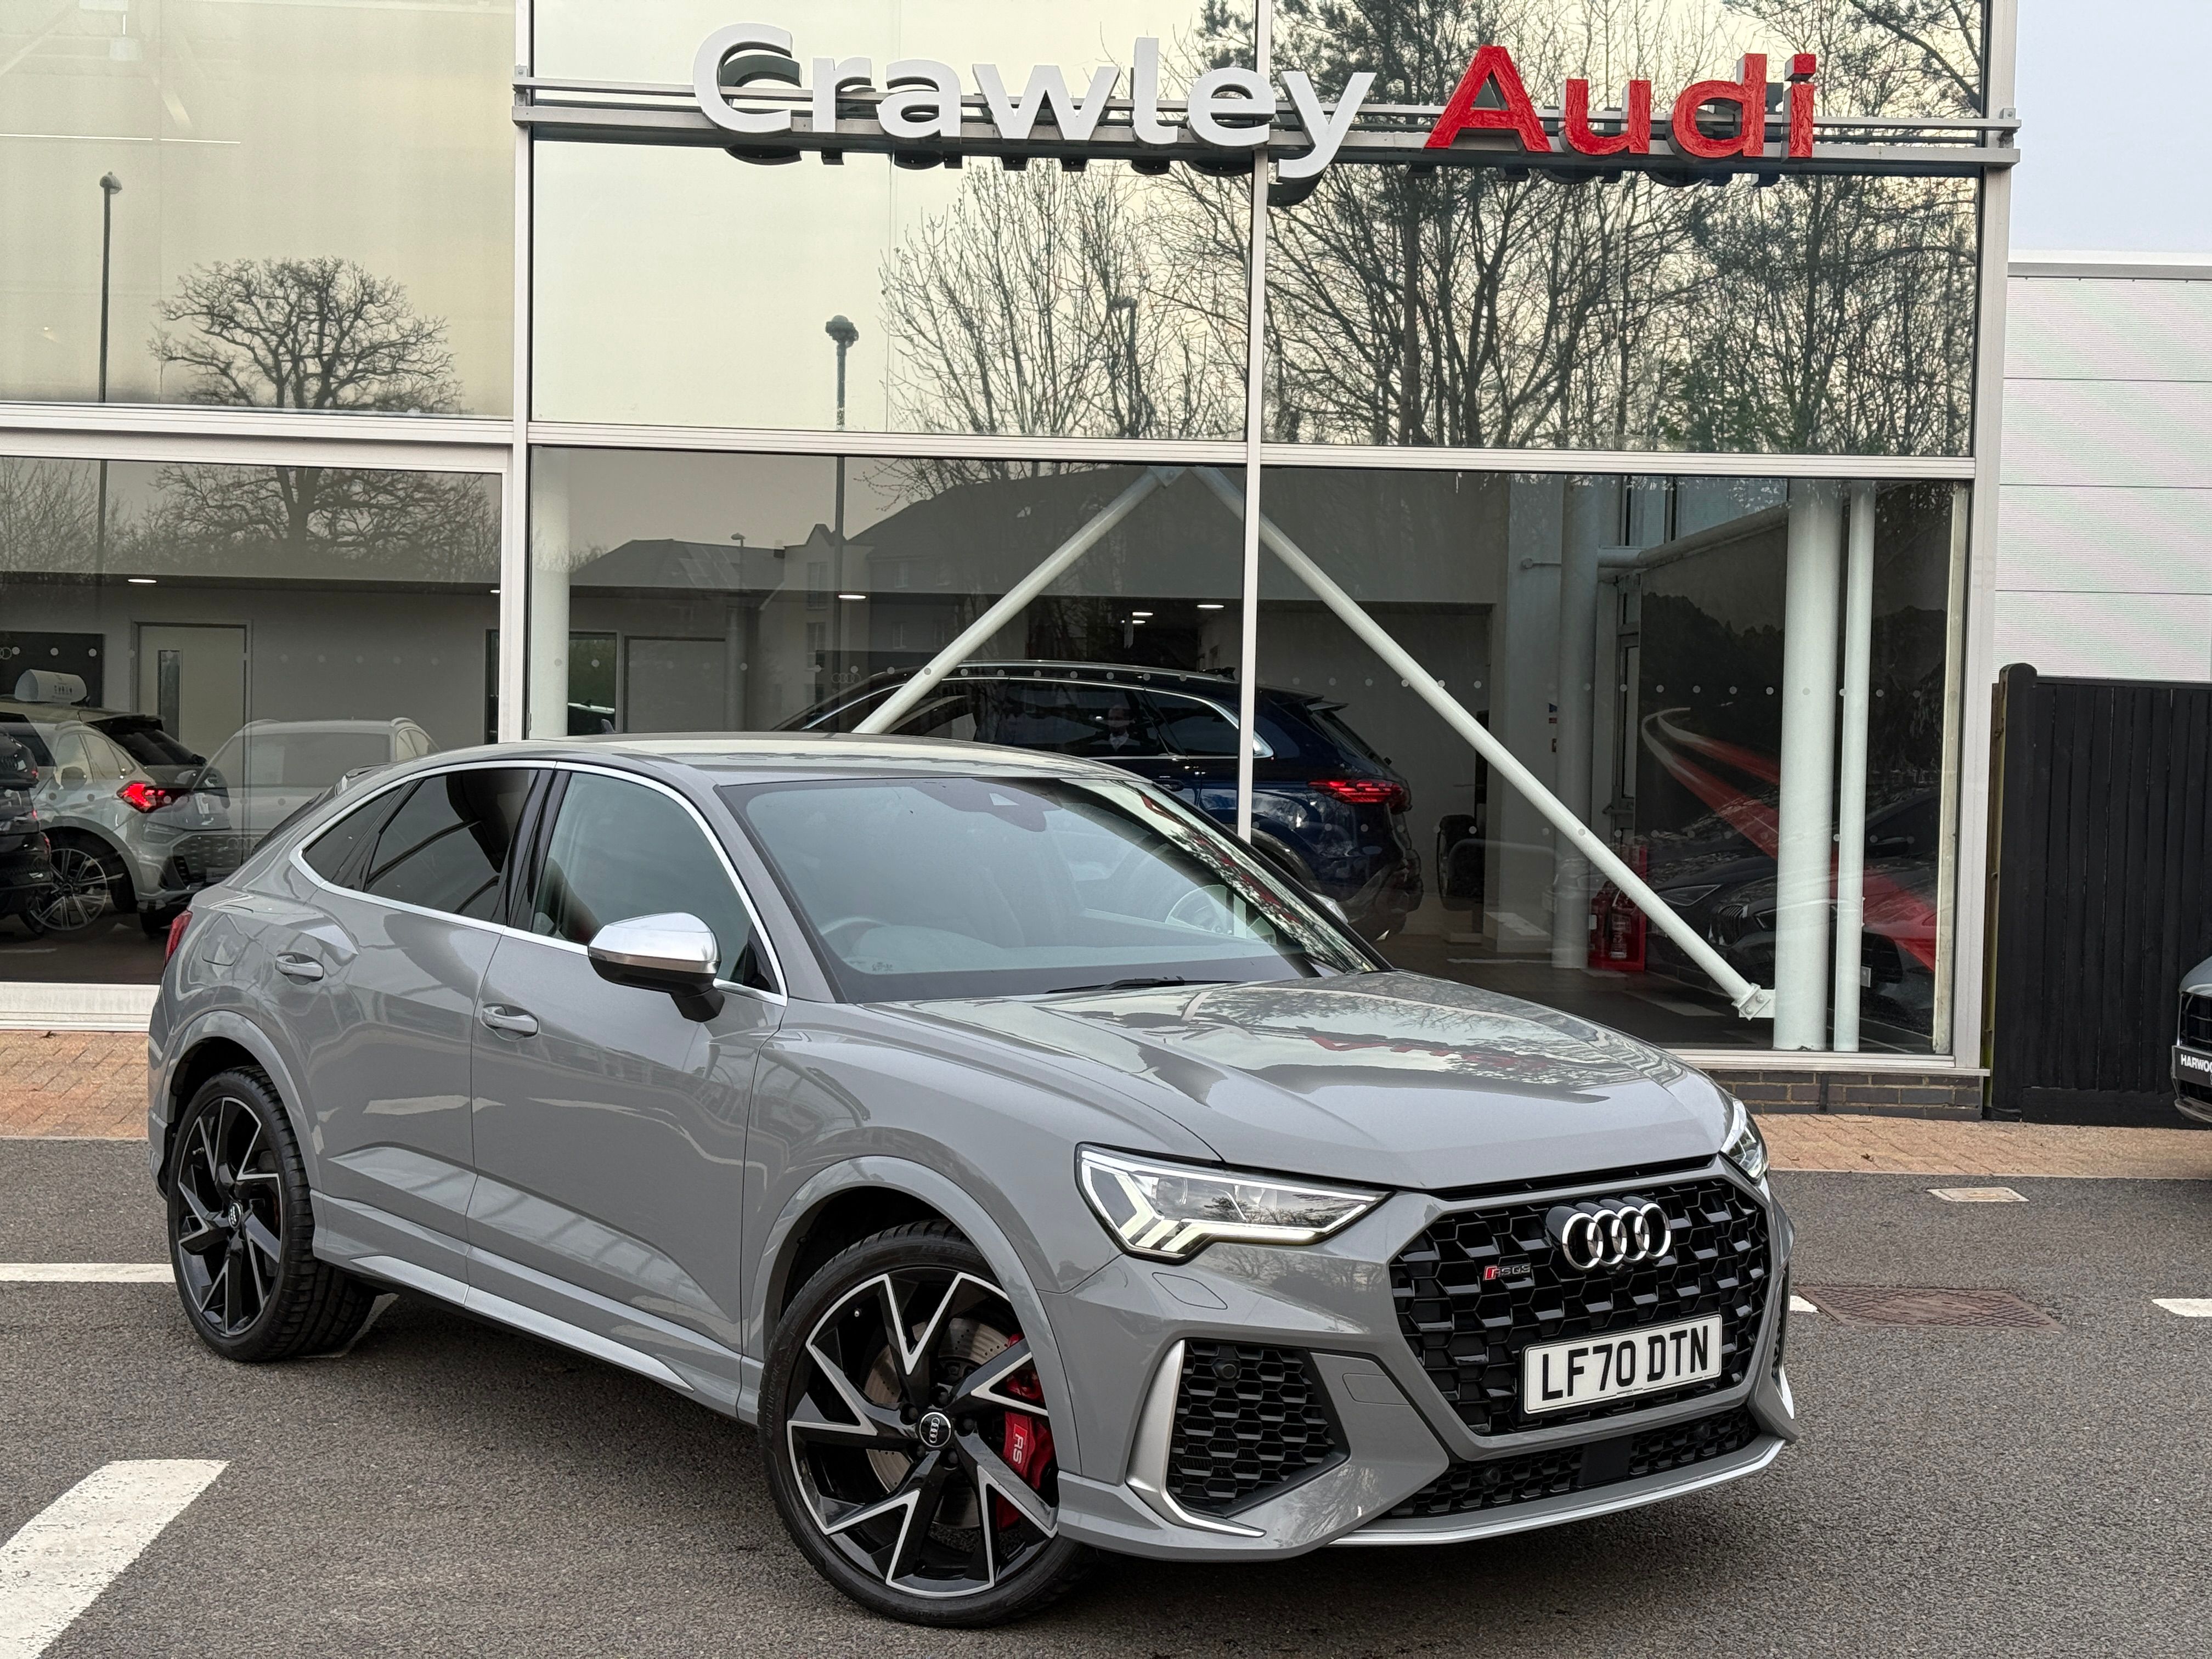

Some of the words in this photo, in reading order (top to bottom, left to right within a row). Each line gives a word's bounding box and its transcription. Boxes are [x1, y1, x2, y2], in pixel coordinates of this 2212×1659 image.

[693, 22, 1376, 179] Crawley
[1421, 45, 1816, 160] Audi
[1542, 1340, 1636, 1401] LF70
[1647, 1325, 1708, 1382] DTN
[1013, 1429, 1025, 1464] RS
